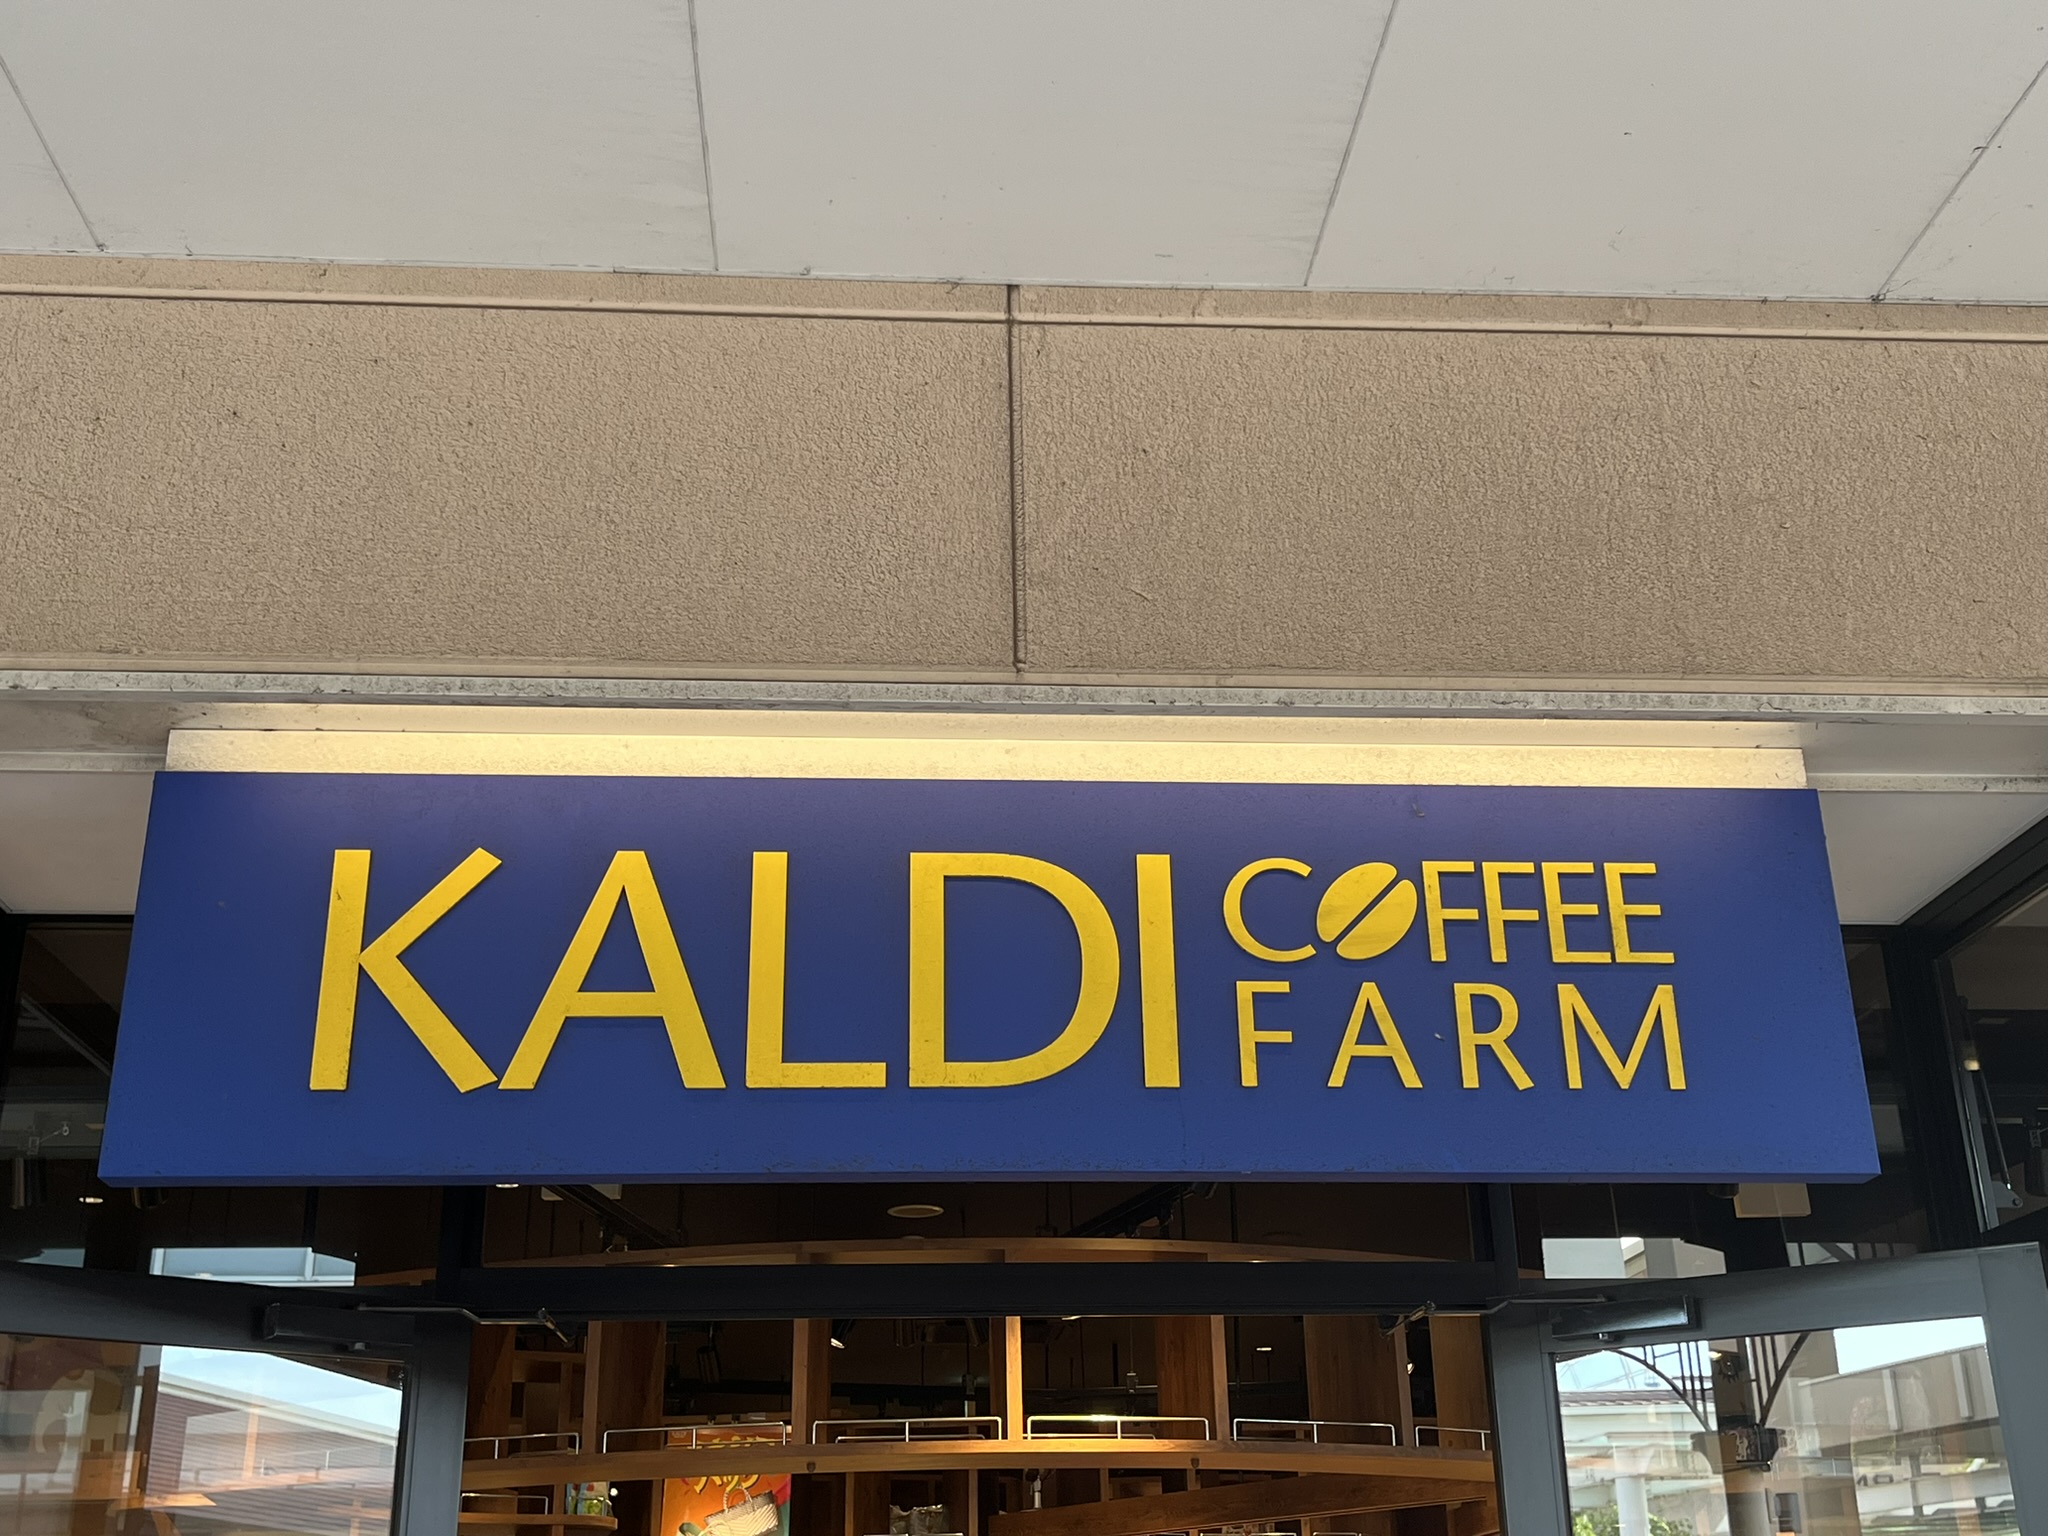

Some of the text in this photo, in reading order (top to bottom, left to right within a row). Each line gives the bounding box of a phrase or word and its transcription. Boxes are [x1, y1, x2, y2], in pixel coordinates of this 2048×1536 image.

[1222, 856, 1676, 964] COFFEE
[308, 847, 1182, 1094] KALDI
[1235, 980, 1688, 1091] FARM
